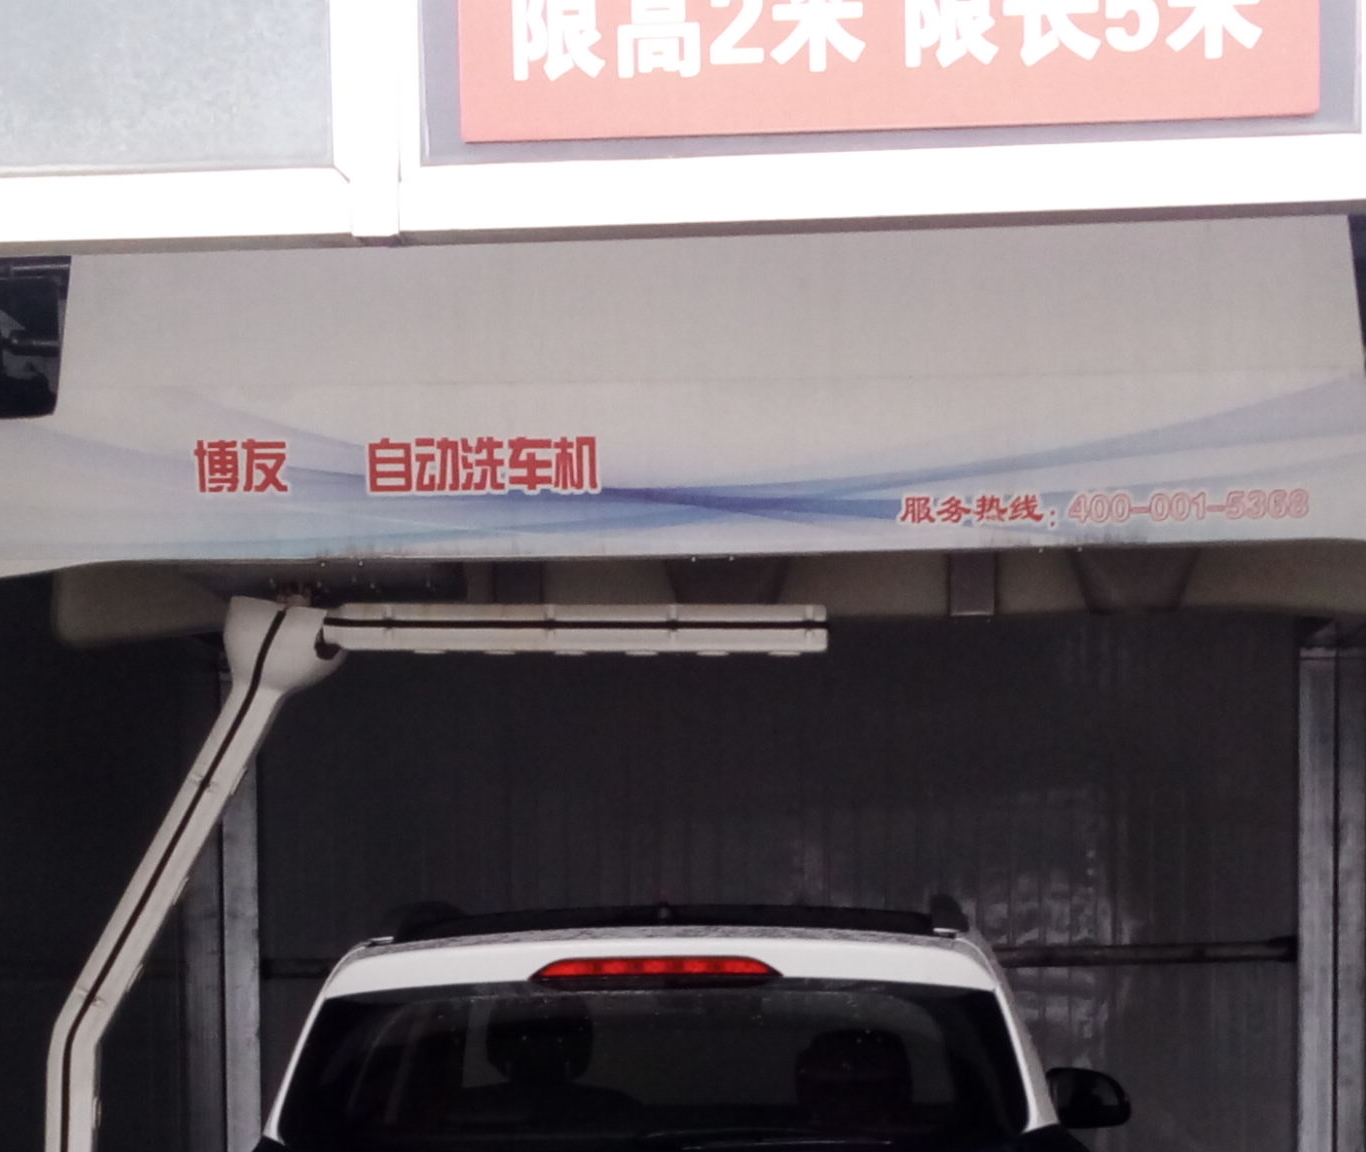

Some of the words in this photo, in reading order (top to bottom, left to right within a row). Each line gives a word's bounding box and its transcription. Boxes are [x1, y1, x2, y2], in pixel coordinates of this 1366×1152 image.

[512, 0, 866, 81] 限高2米
[194, 438, 290, 493] 博友
[367, 437, 599, 492] 自动洗车机
